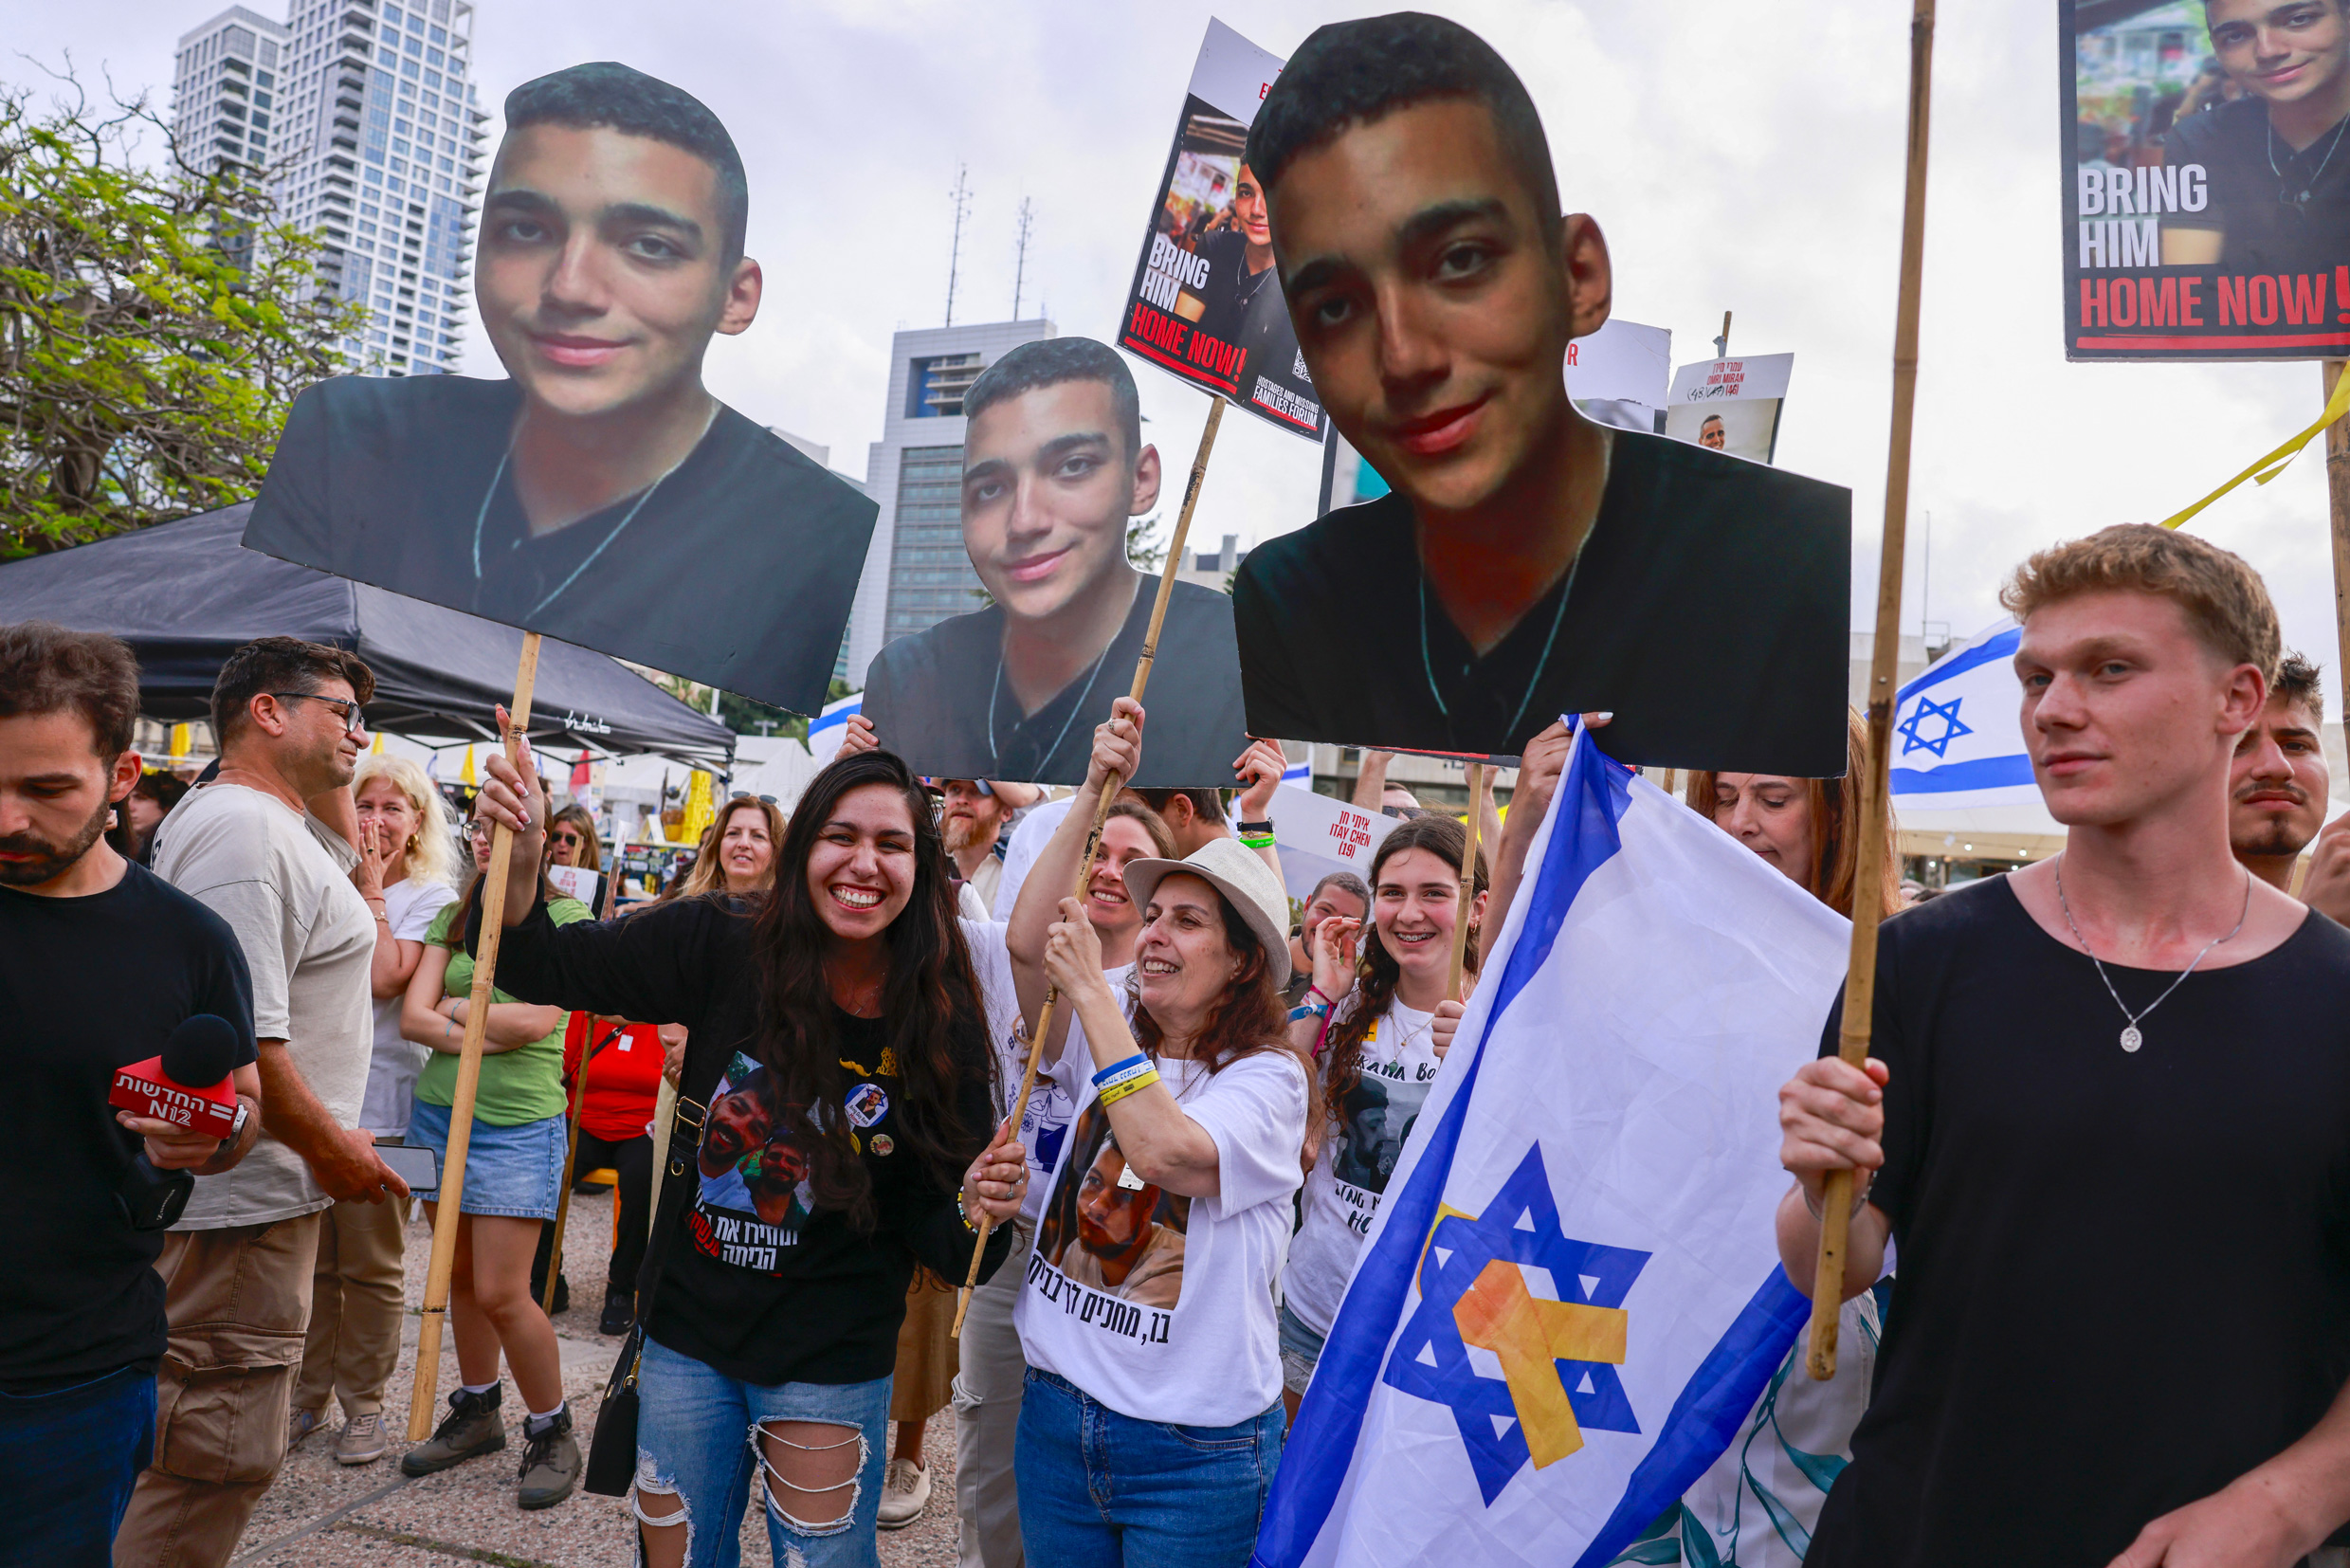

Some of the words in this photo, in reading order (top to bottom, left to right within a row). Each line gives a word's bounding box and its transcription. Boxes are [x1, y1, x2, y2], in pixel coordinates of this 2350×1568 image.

[2078, 163, 2208, 215] BRING
[2079, 218, 2159, 268] HIM
[1148, 237, 1210, 290] BRING
[1139, 267, 1182, 313] HIM
[2080, 277, 2204, 327] HOME
[1130, 301, 1188, 356] HOME
[1187, 330, 1248, 383] NOW!
[1256, 374, 1284, 396] HOSTAGES
[1283, 389, 1296, 402] AND
[1295, 394, 1320, 414] MISSING
[1706, 374, 1722, 385] OMRI
[1722, 373, 1745, 384] MIRAN
[1252, 385, 1288, 414] FAMILIES
[1288, 402, 1318, 428] FORUM
[1329, 823, 1350, 840] ITAY
[1349, 830, 1372, 848] CHEN
[1339, 811, 1350, 825] חן
[1352, 813, 1371, 831] איתי
[1338, 840, 1356, 859] (19)
[116, 1074, 205, 1112] החדשות
[149, 1100, 191, 1127] N12
[715, 1216, 741, 1243] את
[722, 1244, 777, 1270] הביתה
[1065, 1281, 1082, 1315] לך
